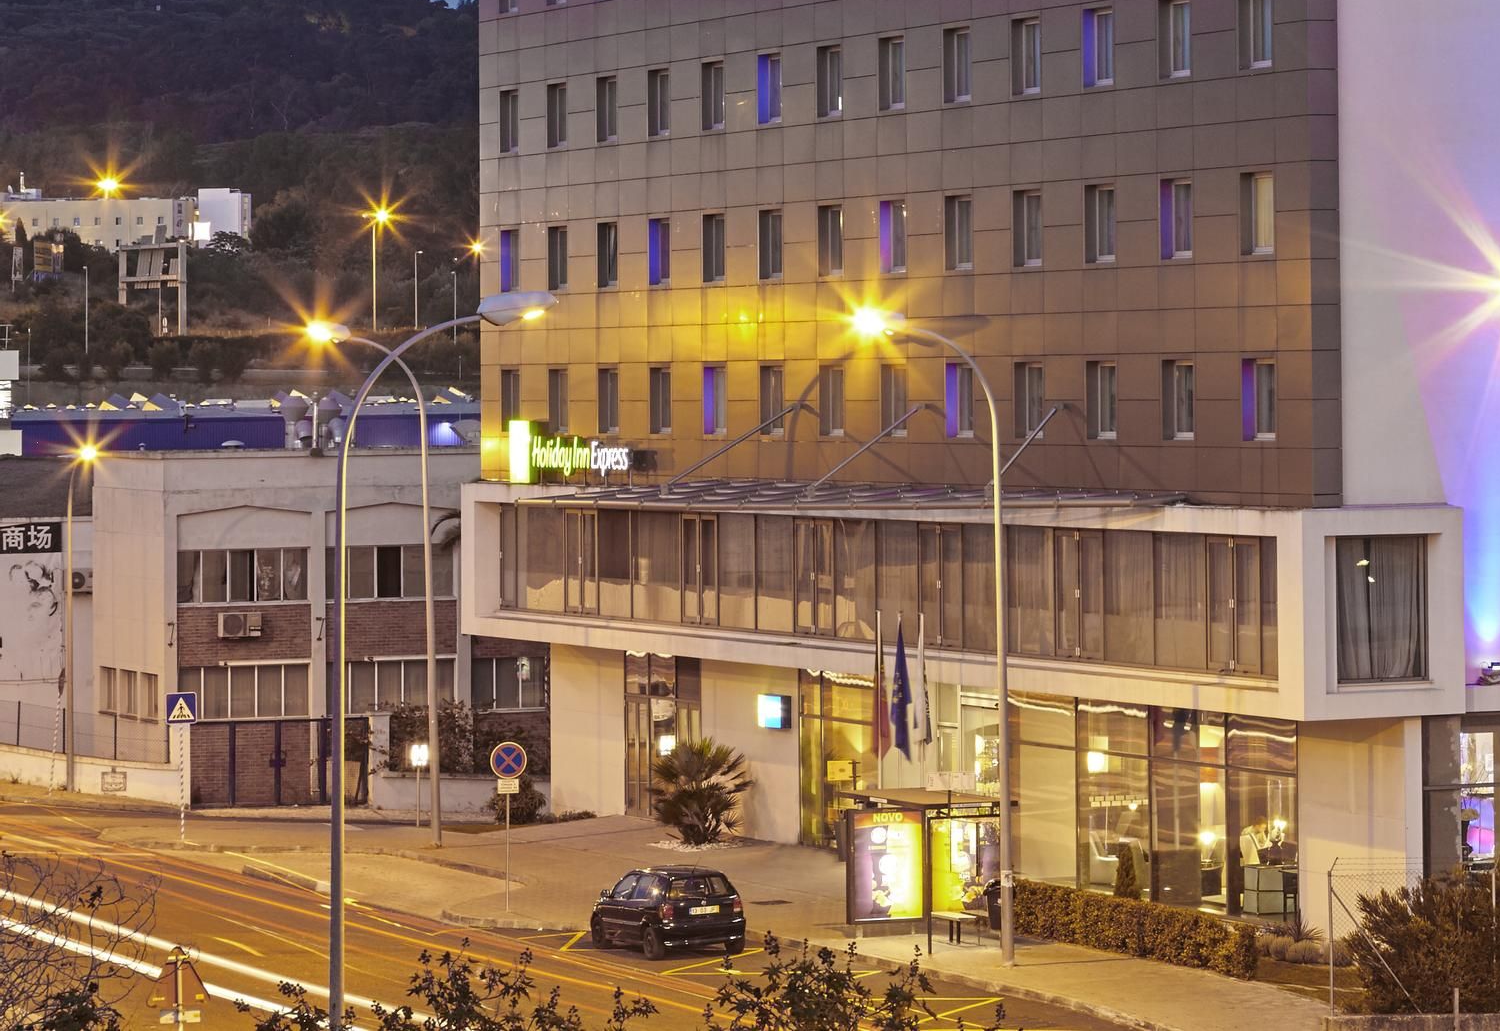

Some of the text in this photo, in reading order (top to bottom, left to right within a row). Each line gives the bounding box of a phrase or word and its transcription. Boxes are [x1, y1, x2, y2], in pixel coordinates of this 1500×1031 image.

[532, 435, 629, 477] Holiday Inn Express
[0, 525, 52, 551] 商场
[873, 812, 904, 823] NOVO
